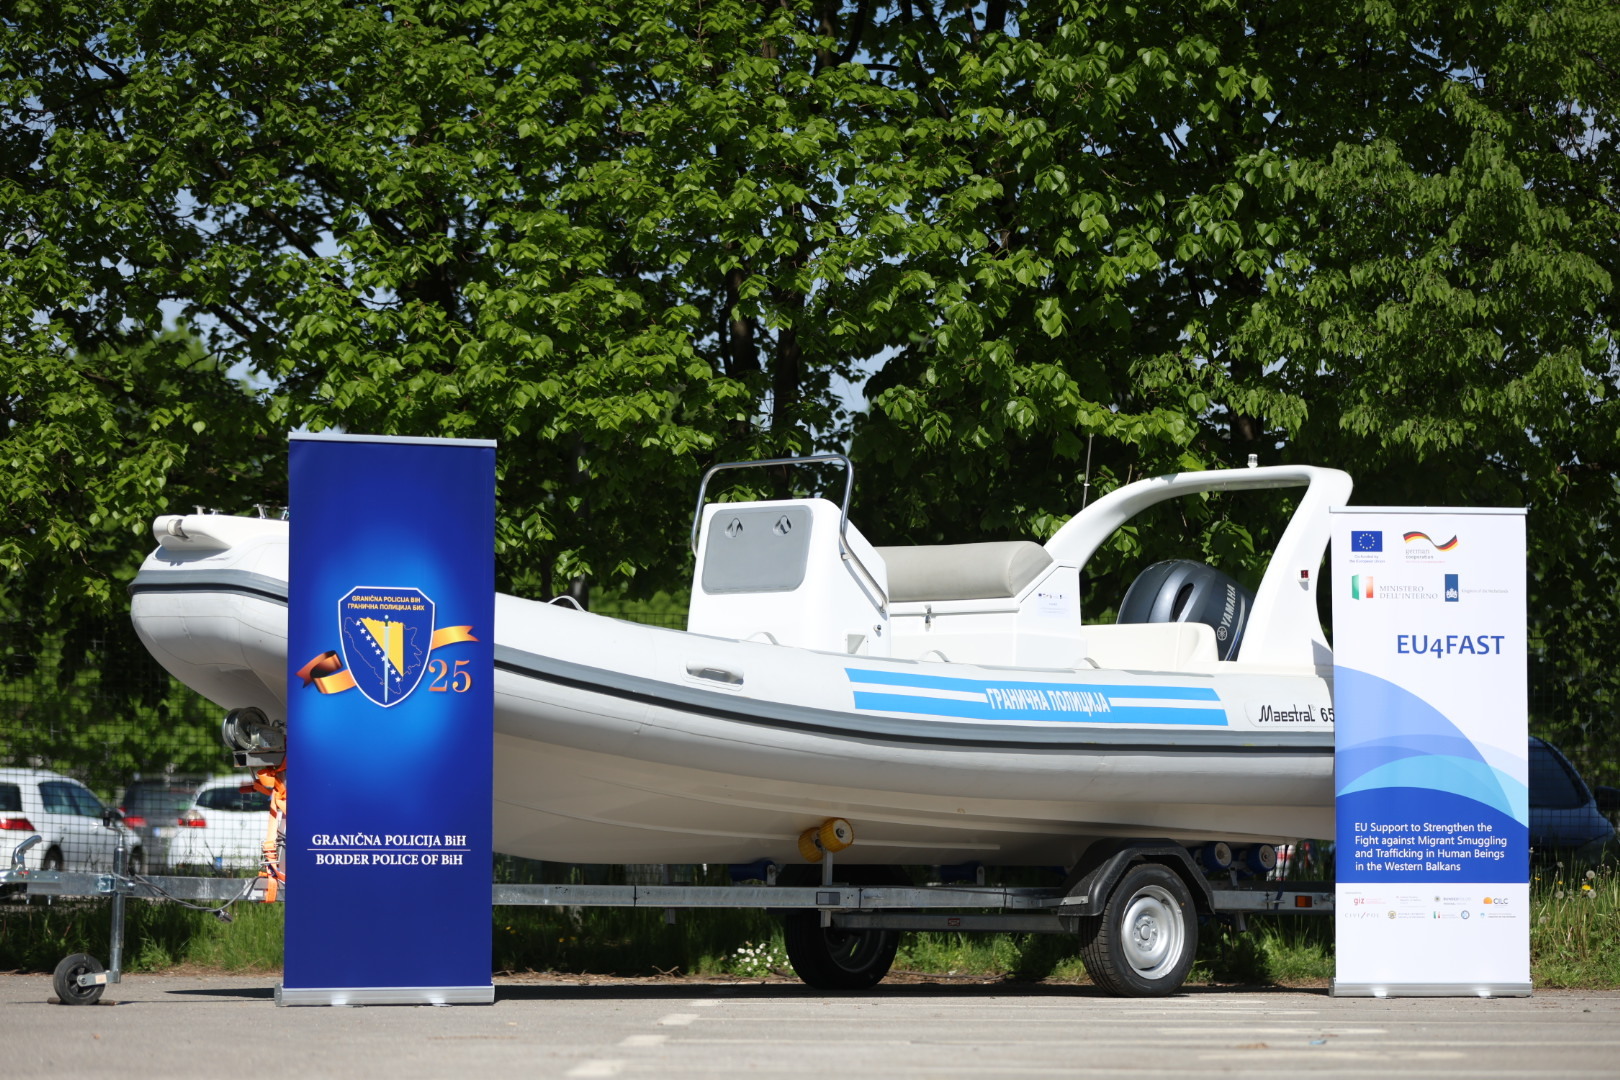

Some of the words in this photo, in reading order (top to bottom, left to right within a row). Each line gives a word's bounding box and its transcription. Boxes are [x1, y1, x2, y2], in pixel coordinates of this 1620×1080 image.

[1220, 583, 1236, 628] YAMAHA
[1397, 634, 1505, 659] EU4FAST
[428, 659, 472, 693] 25
[986, 688, 1051, 711] ГРАНИЧНА
[1046, 690, 1111, 717] ПОЛИЦИЈА
[1354, 823, 1368, 832] EU
[1370, 823, 1408, 834] Support
[1411, 824, 1421, 832] to
[1423, 823, 1475, 834] Strengthen
[1477, 823, 1492, 832] the
[312, 832, 382, 846] GRANIČNA
[385, 834, 441, 847] POLICIJA
[444, 835, 466, 846] BiH
[1355, 836, 1379, 847] Fight
[1381, 836, 1415, 847] against
[1418, 836, 1455, 847] Migrant
[1457, 836, 1507, 847] Smuggling
[315, 854, 370, 865] BORDER
[372, 854, 418, 865] POLICE
[421, 854, 438, 865] OF
[441, 855, 463, 865] BiH
[1355, 849, 1373, 858] and
[1376, 849, 1423, 860] Trafficking
[1426, 849, 1435, 858] in
[1437, 849, 1471, 858] Human
[1474, 849, 1505, 860] Beings
[1355, 862, 1364, 871] in
[1366, 862, 1382, 871] the
[1384, 862, 1423, 871] Western
[1425, 862, 1461, 871] Balkans
[1353, 897, 1365, 906] giz
